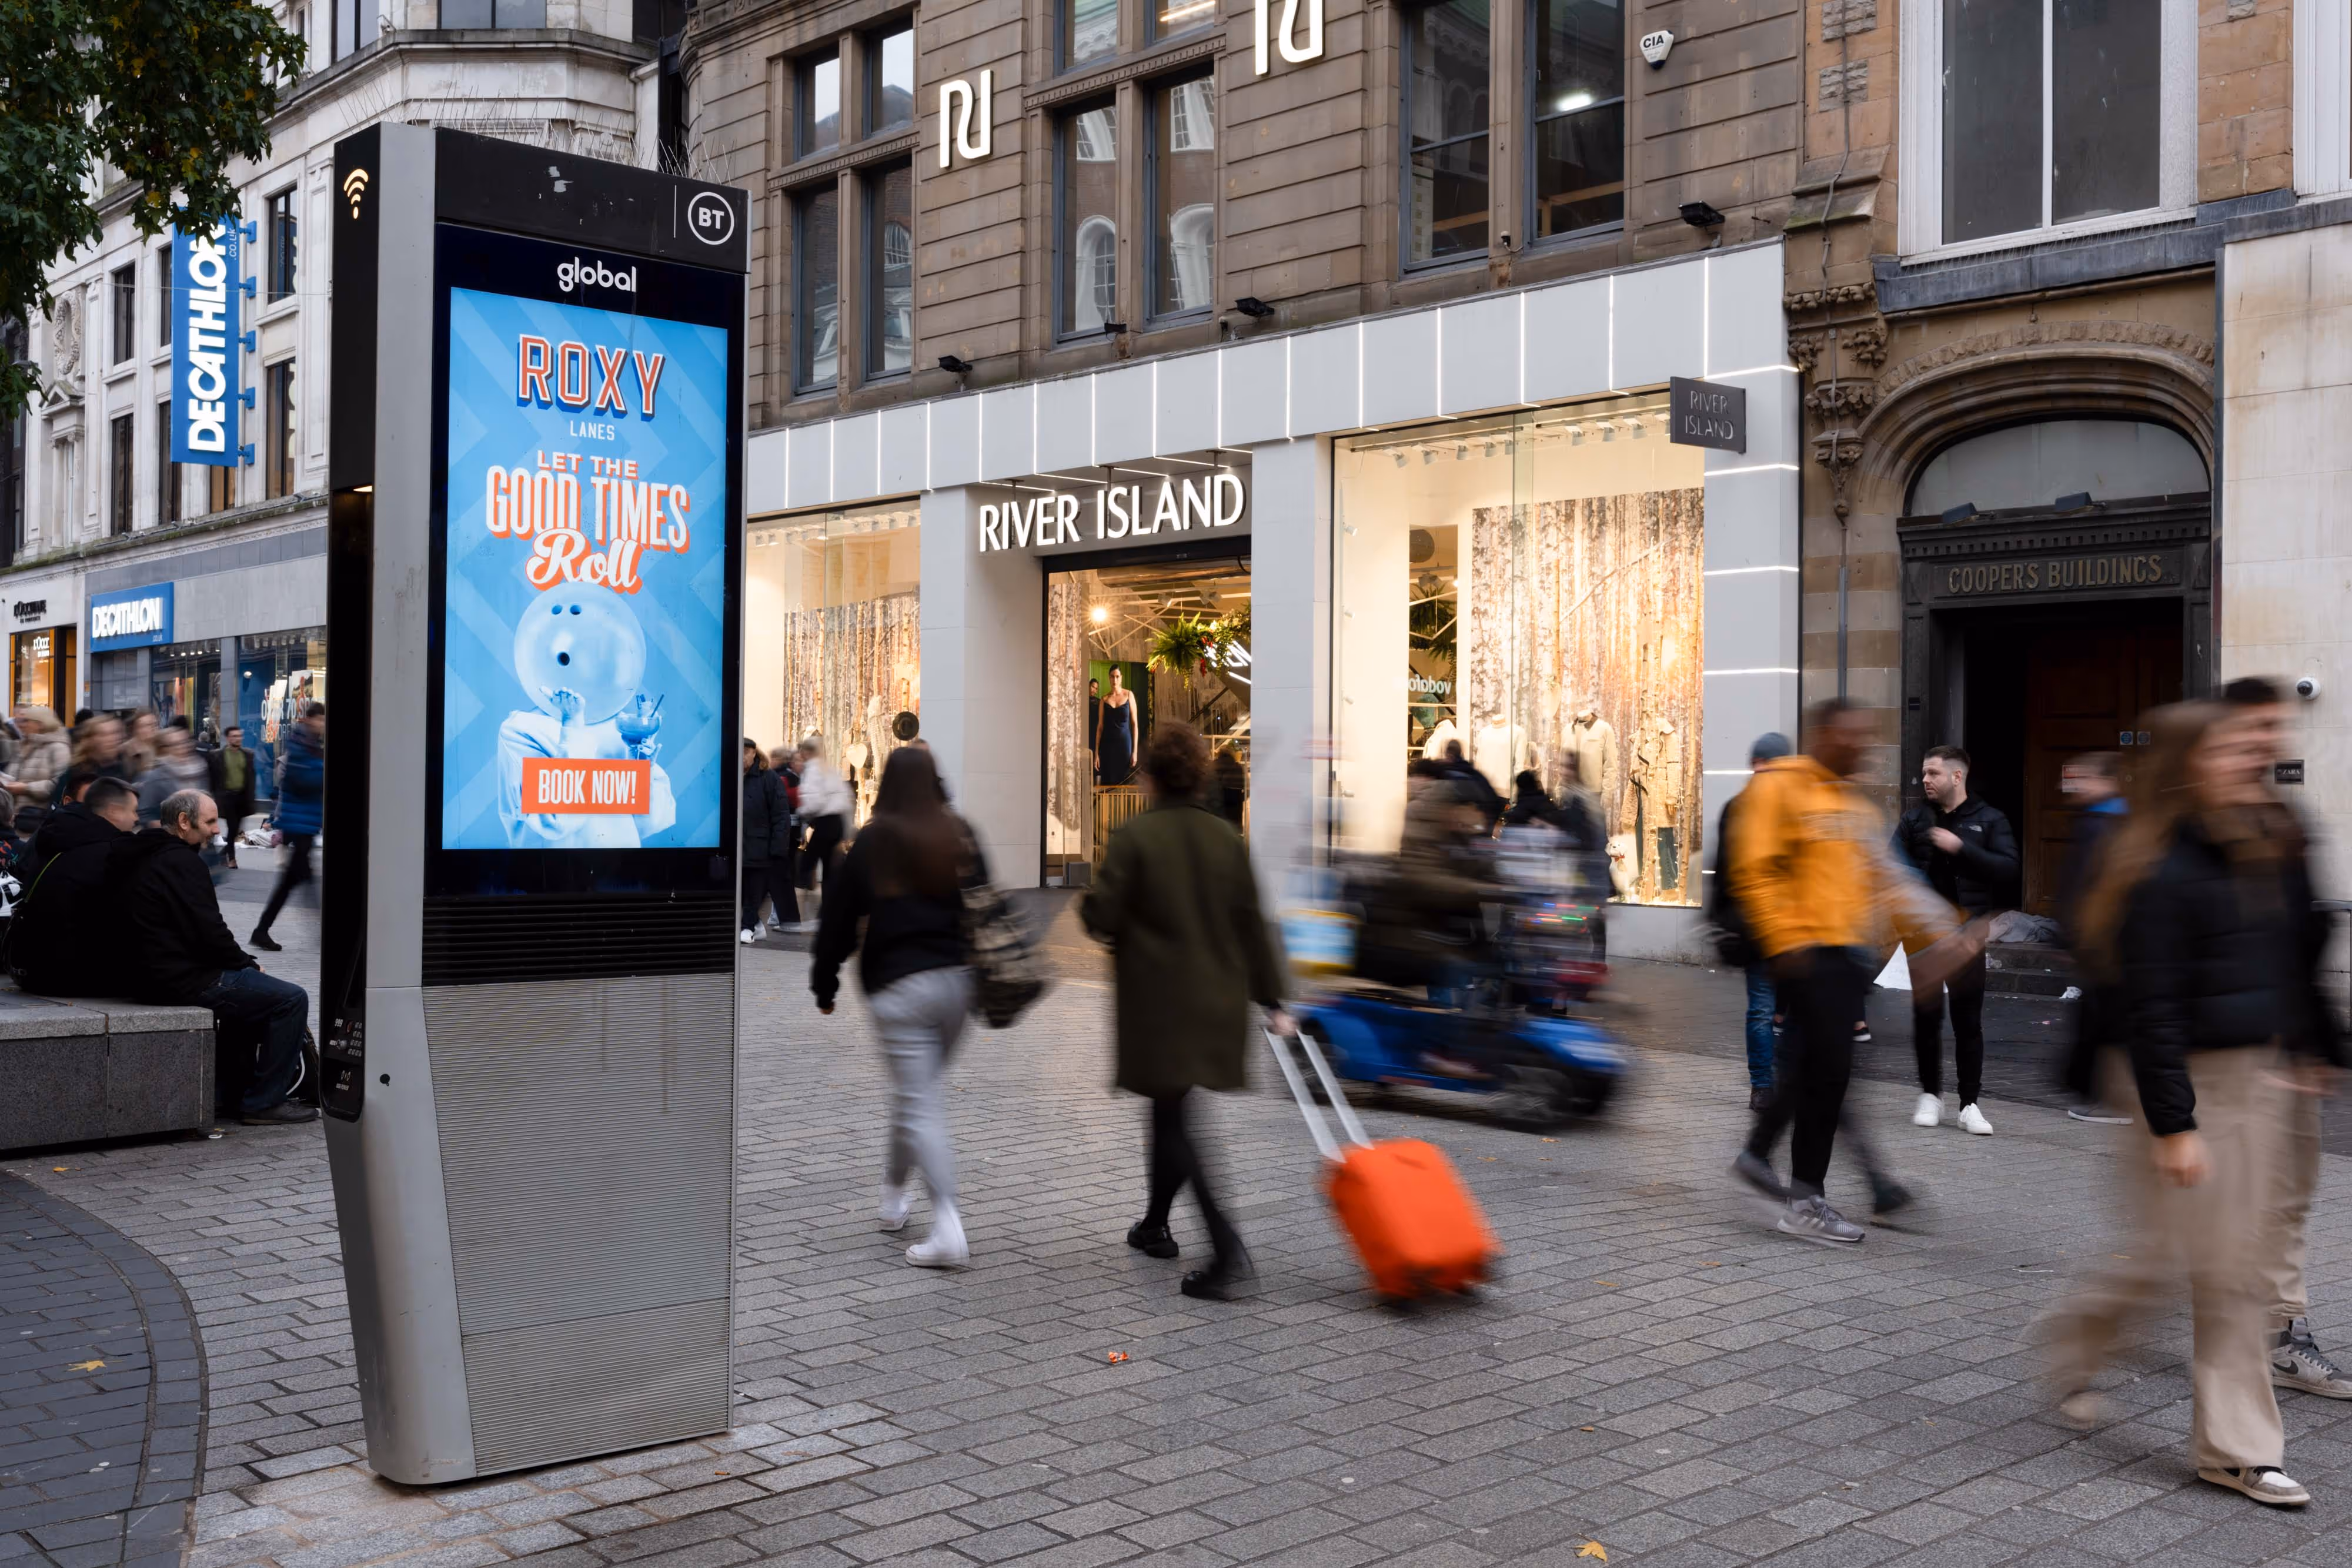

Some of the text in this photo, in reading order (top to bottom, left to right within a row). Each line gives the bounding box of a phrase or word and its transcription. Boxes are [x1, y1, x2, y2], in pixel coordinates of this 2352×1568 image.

[1643, 35, 1664, 48] CIA
[699, 207, 724, 229] BT
[227, 228, 237, 260] .co.uk
[557, 256, 636, 292] global
[188, 222, 227, 452] DECATHLON
[517, 334, 665, 419] ROXY
[1690, 390, 1729, 414] RIVER
[570, 420, 615, 440] LANES
[1685, 414, 1733, 440] ISLAND
[537, 450, 638, 479] LET THE
[486, 465, 689, 553] GOOD TIMES
[980, 474, 1246, 551] RIVER ISLAND
[526, 527, 642, 594] Roll
[2048, 555, 2162, 587] BUILDINGS
[92, 597, 163, 638] DECATHLON
[538, 769, 637, 804] BOOK NOW!
